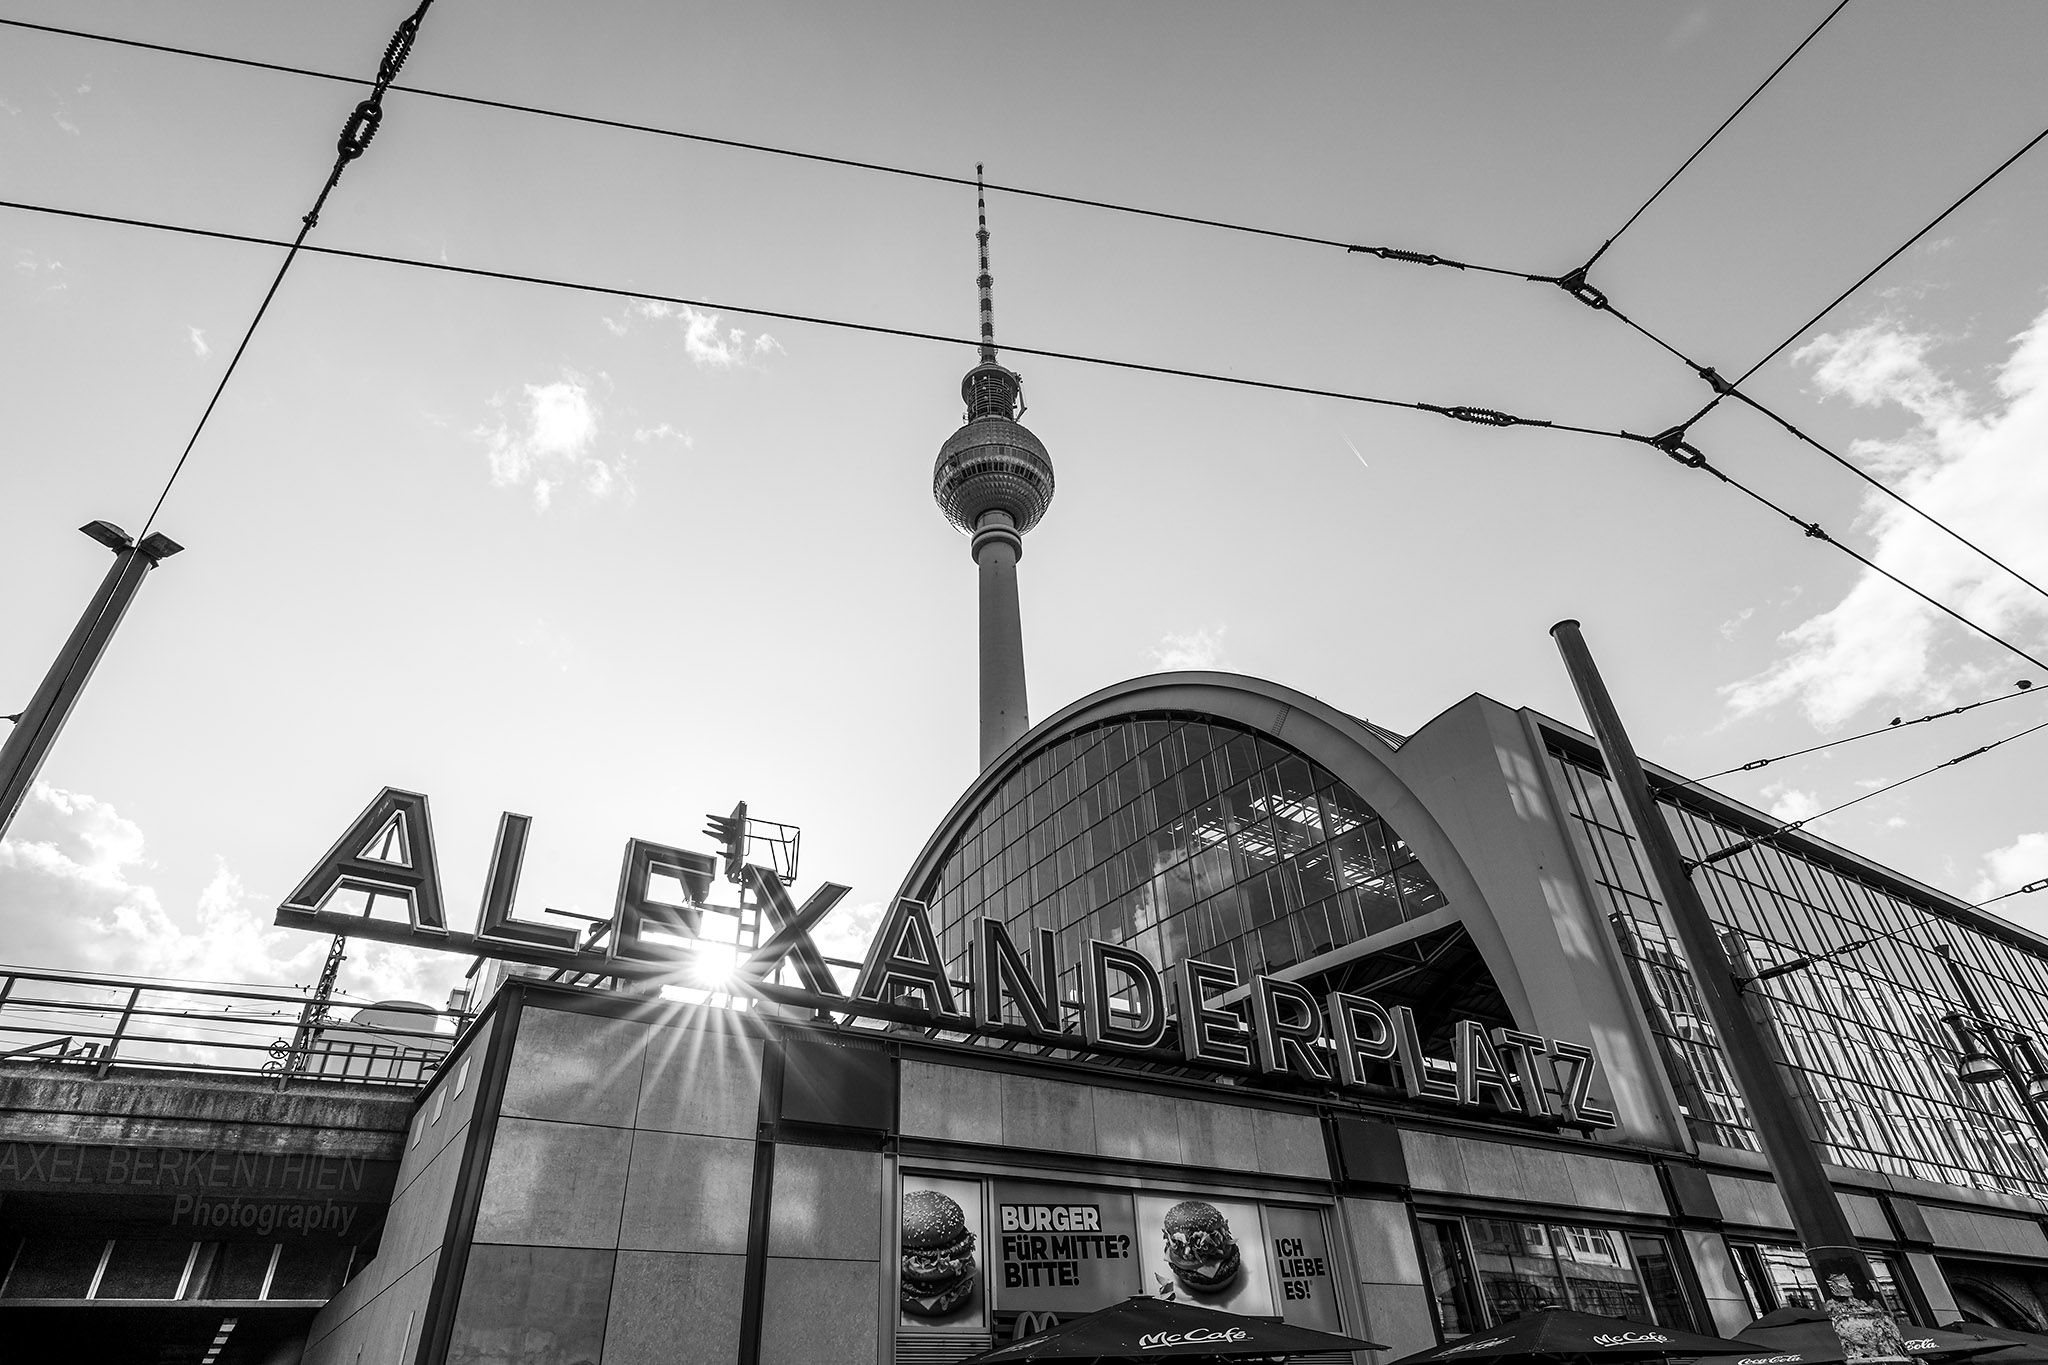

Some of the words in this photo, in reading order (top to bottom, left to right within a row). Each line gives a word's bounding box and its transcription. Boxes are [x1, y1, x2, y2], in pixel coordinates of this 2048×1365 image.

[275, 785, 1617, 1130] ALEXANDERPLATZ
[1001, 1206, 1100, 1232] BURGER
[1051, 1234, 1131, 1260] MITTE?
[1275, 1238, 1305, 1257] ICH
[1004, 1261, 1080, 1288] BITTE!
[1279, 1258, 1326, 1278] LIEBE
